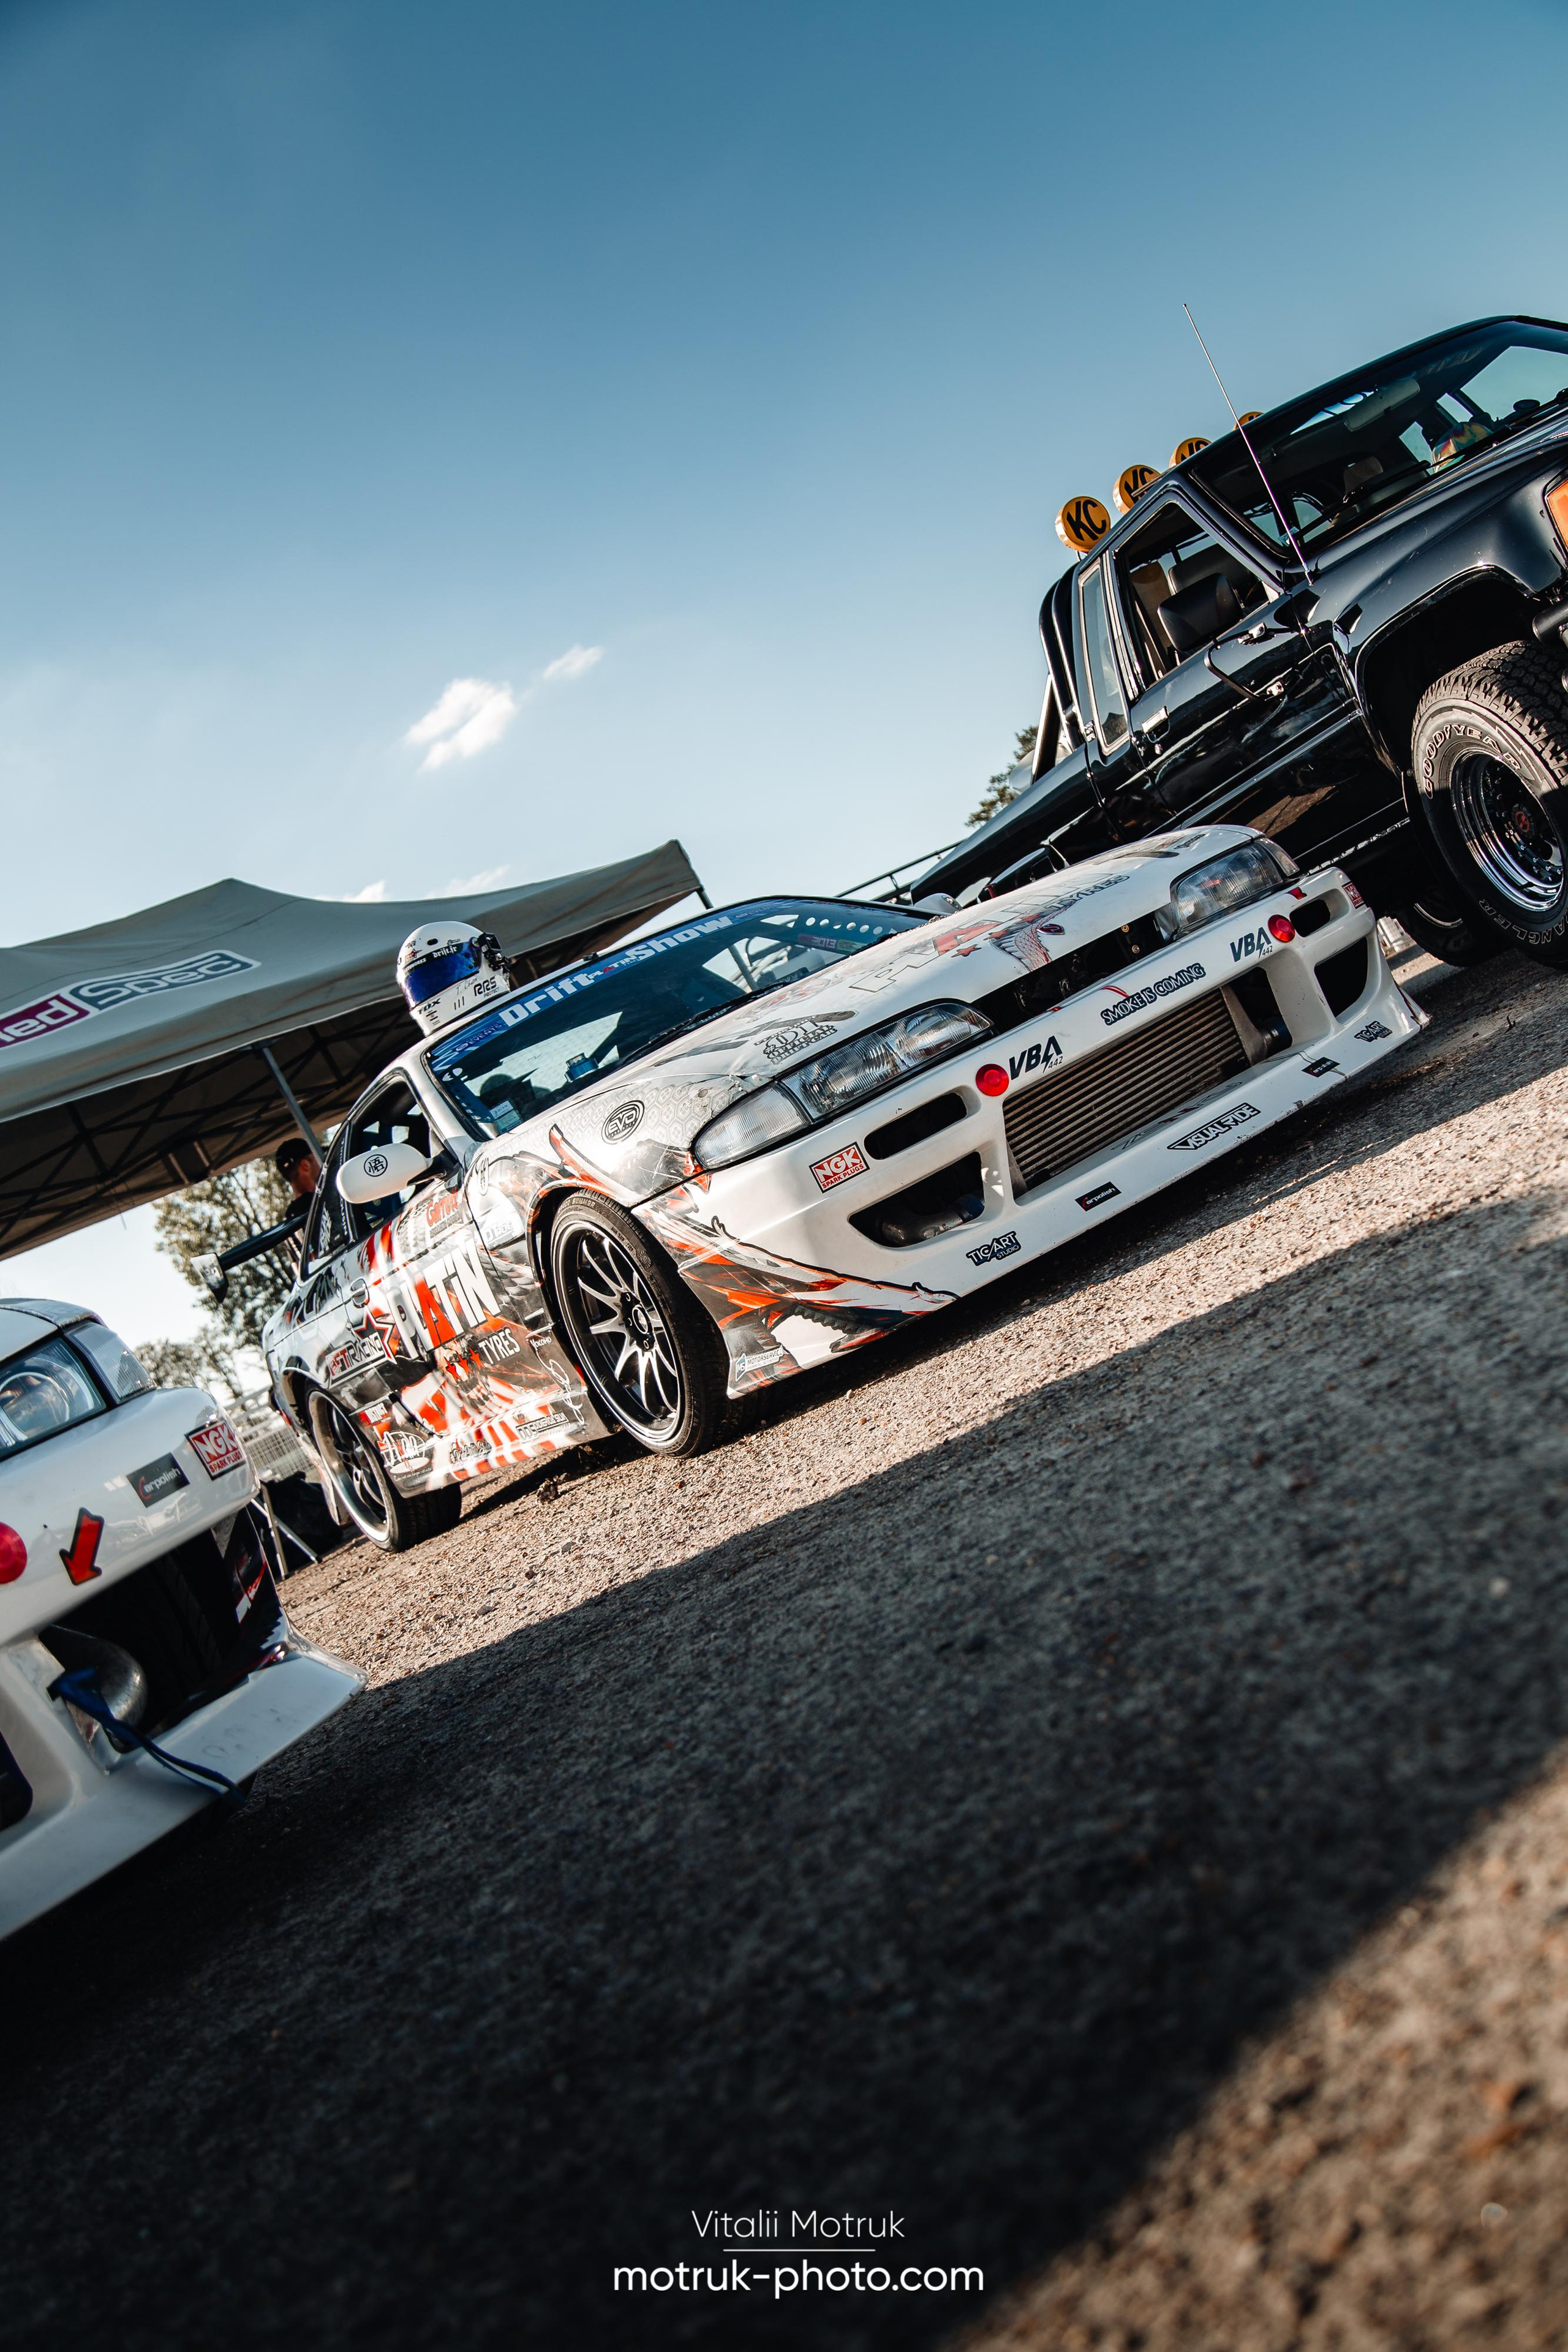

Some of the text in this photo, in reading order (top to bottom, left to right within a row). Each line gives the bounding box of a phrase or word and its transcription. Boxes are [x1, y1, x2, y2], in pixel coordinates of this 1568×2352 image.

[1066, 499, 1106, 541] KC
[1051, 875, 1130, 909] TYRES
[1479, 899, 1568, 944] ANGLER
[625, 916, 733, 962] Show
[1229, 927, 1273, 962] VBA 442
[78, 954, 241, 1005] Spec
[473, 977, 497, 997] RRS
[484, 987, 499, 998] PROTECT
[1102, 965, 1204, 1024] SMOKE IS COMING
[418, 998, 441, 1014] FOX
[499, 974, 594, 1027] Drift
[1009, 1035, 1063, 1080] VBA 442
[608, 1109, 636, 1134] EVO
[368, 1156, 385, 1174] 悟
[815, 1148, 860, 1182] NGK
[822, 1164, 864, 1188] SPARK PLUGS
[572, 1198, 595, 1208] SUMMER
[1082, 1187, 1115, 1208] Carpolish
[996, 1244, 1019, 1259] STUDIO
[385, 1237, 502, 1360] PLATIN
[478, 1327, 521, 1365] TYRES
[195, 1426, 238, 1463] NGK
[209, 1451, 243, 1473] SPARK PLUGS
[138, 1468, 181, 1500] Carpolish
